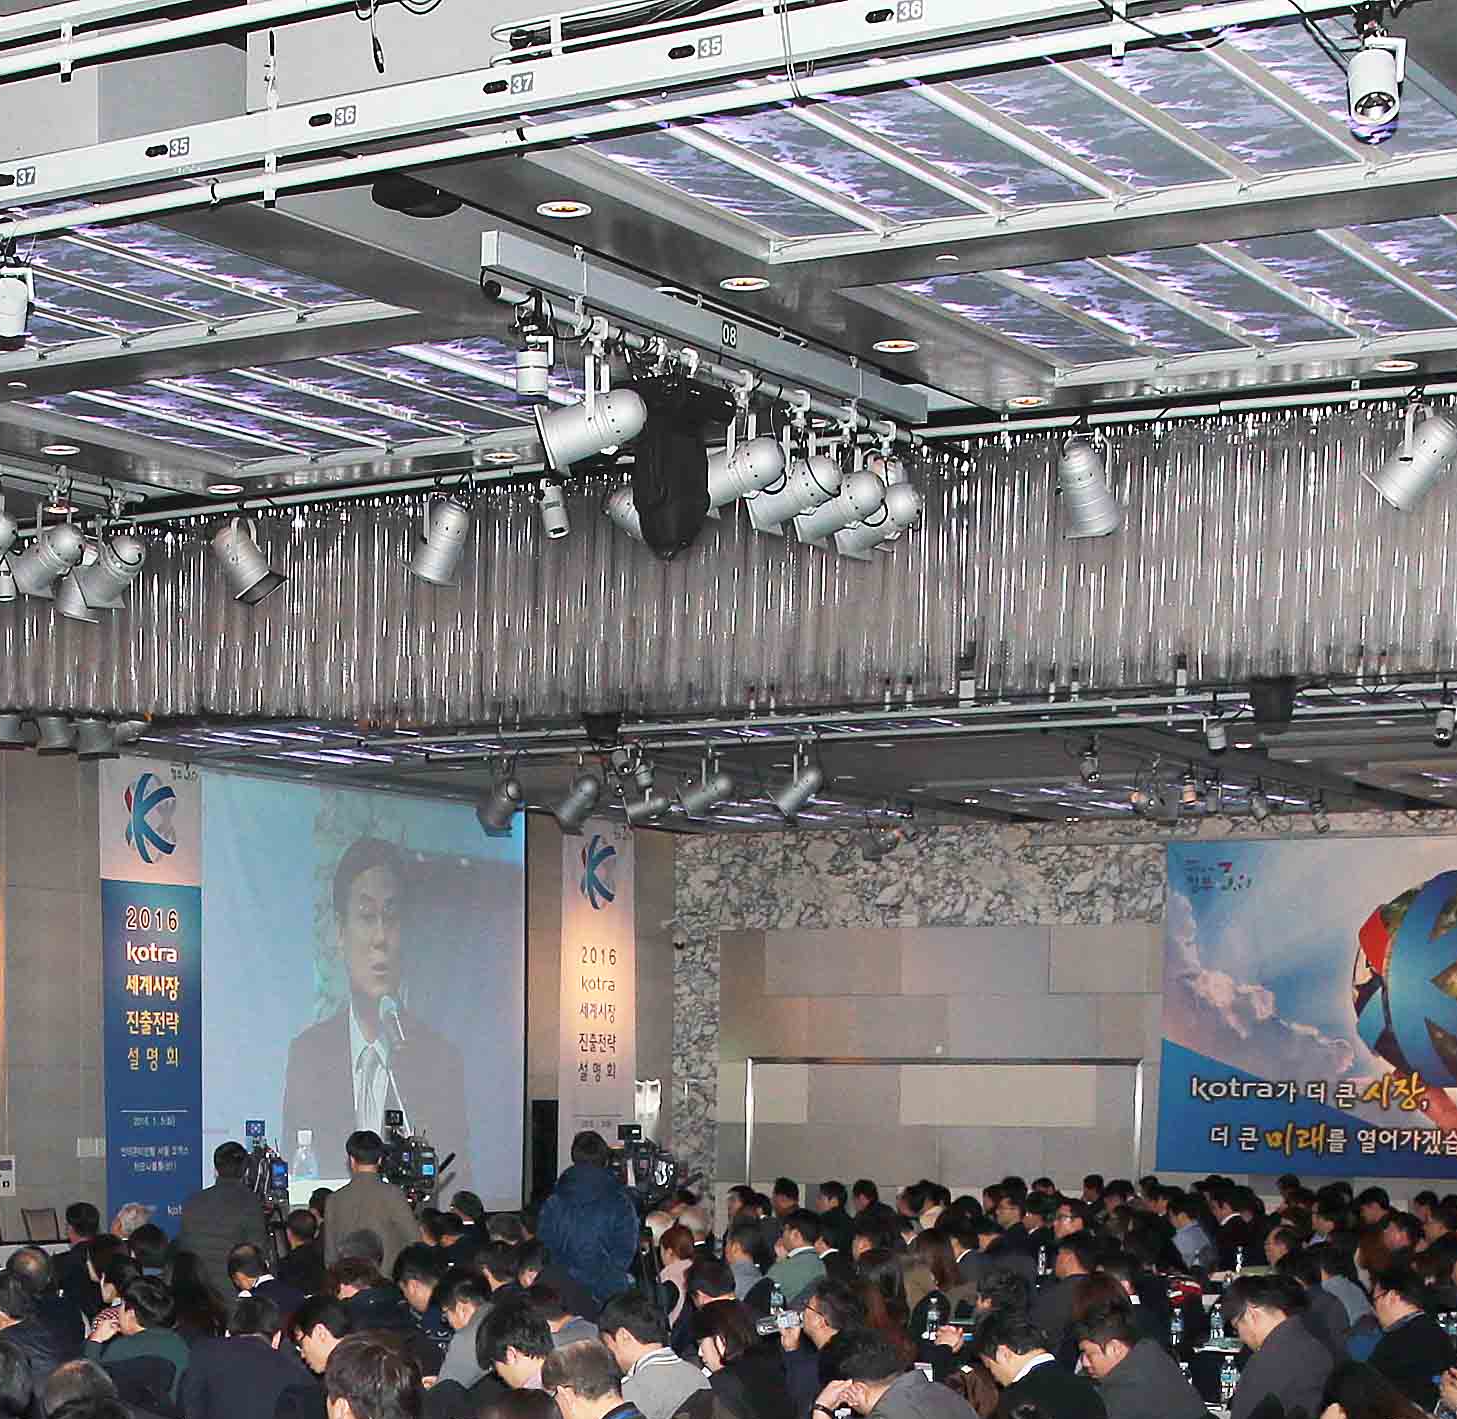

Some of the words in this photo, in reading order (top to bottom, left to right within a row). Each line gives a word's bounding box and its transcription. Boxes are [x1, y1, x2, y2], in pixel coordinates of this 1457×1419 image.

[897, 1, 922, 20] 36
[699, 37, 721, 56] 35
[511, 74, 533, 94] 37
[335, 107, 355, 125] 36
[169, 138, 187, 155] 35
[17, 168, 34, 185] 37
[722, 323, 736, 346] 08
[126, 905, 178, 932] 2016
[126, 941, 178, 964] kotra
[581, 946, 616, 965] 2016
[126, 975, 180, 1001] 세계시장
[581, 975, 616, 992] kotra
[126, 1010, 180, 1036] 진출전략
[579, 1033, 616, 1053] 진출전략
[1191, 1076, 1296, 1104] kotra가
[1307, 1082, 1326, 1104] 더
[1335, 1083, 1357, 1108] 큰
[1362, 1071, 1430, 1111] 시장,
[1210, 1125, 1229, 1147] 더
[1238, 1127, 1259, 1151] 큰
[1264, 1122, 1348, 1156] 미래를
